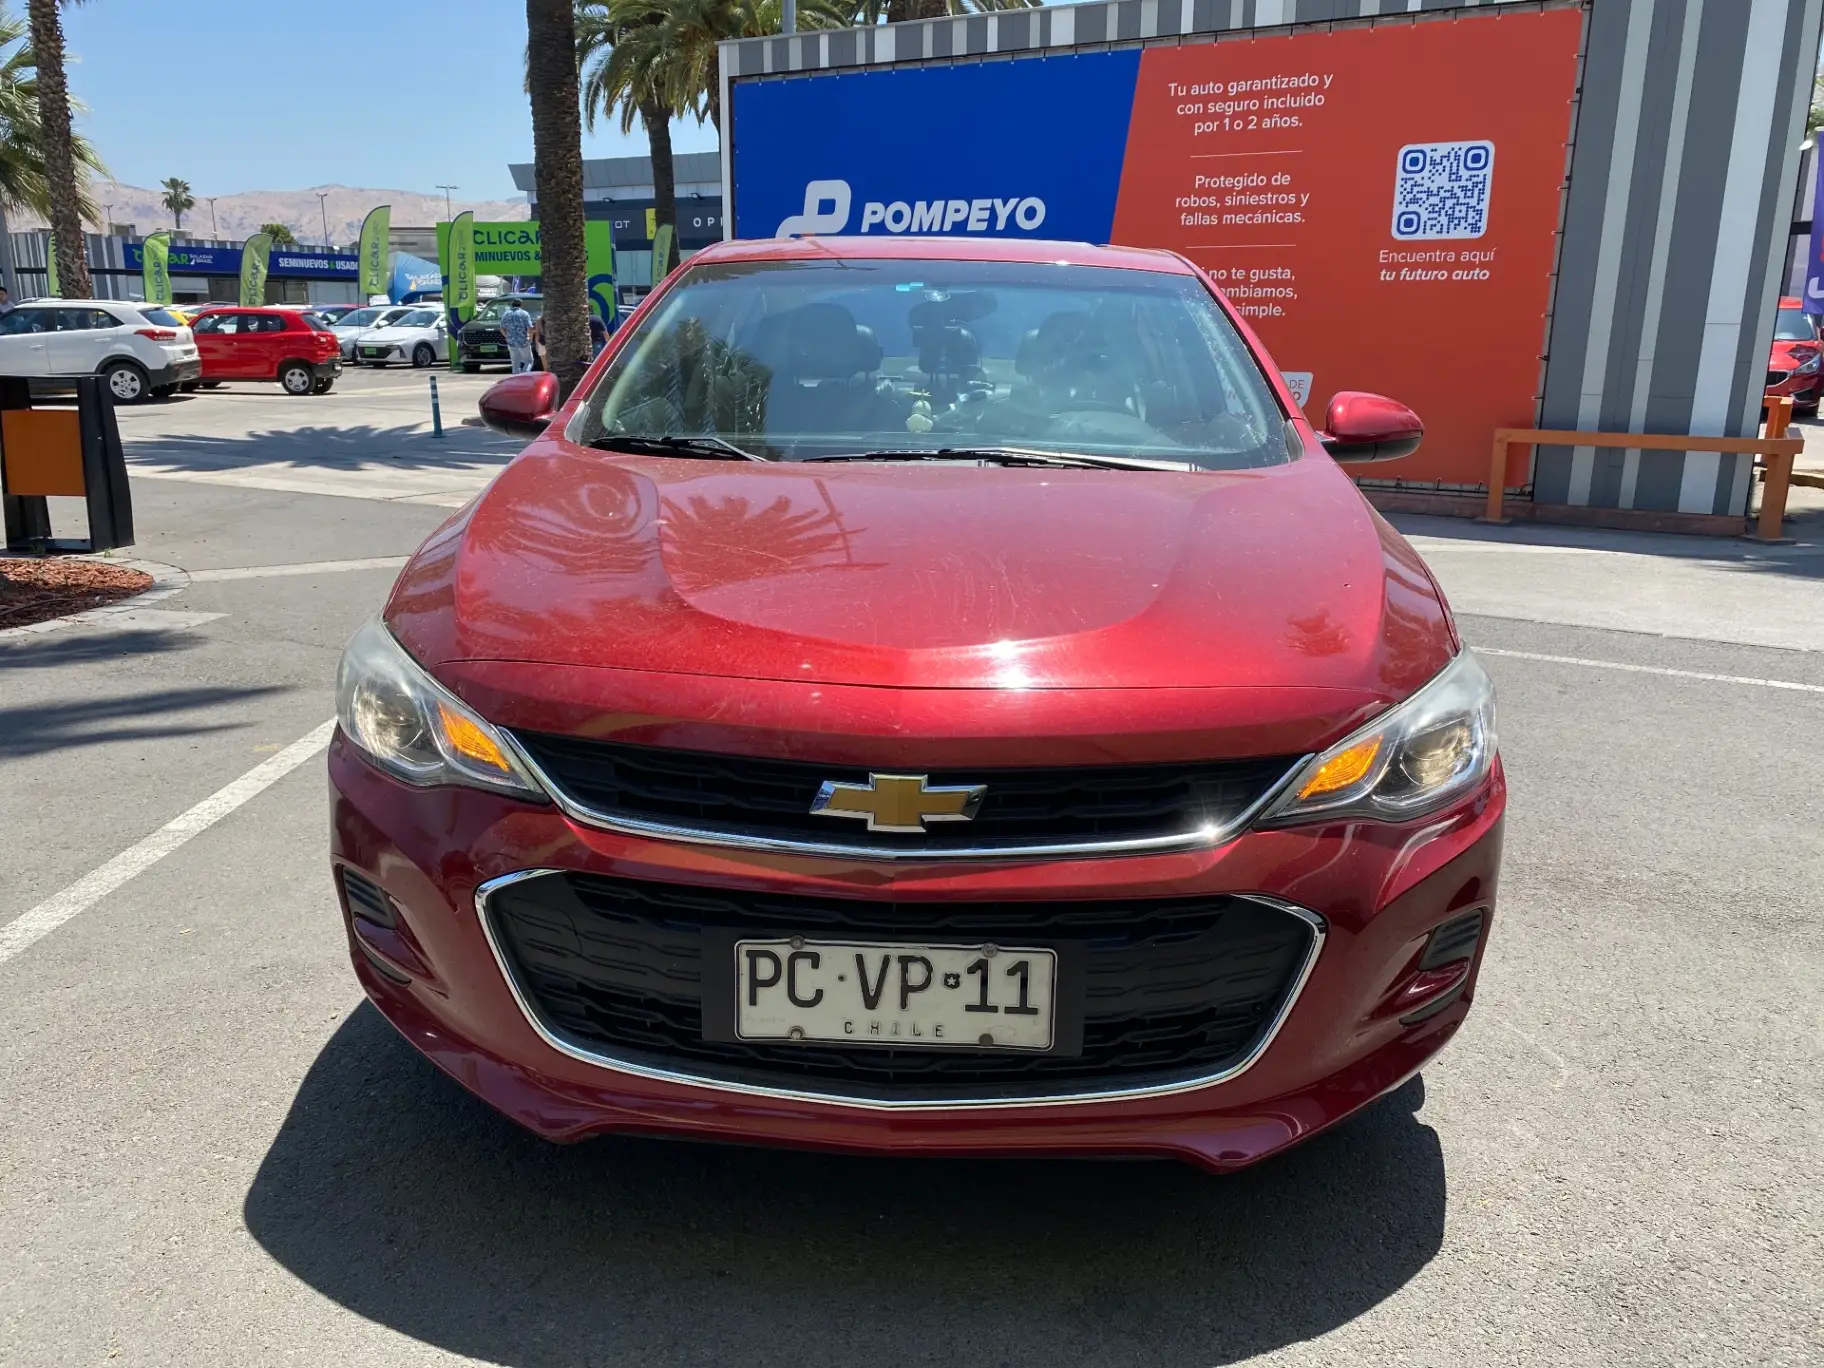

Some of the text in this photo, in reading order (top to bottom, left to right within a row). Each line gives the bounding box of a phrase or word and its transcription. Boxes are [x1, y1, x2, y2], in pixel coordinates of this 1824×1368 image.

[1168, 72, 1334, 97] Tu auto garantizado y
[1176, 92, 1325, 116] con seguro incluido
[1194, 113, 1303, 136] por 1 o 2 años.
[1195, 171, 1291, 190] Protegido de
[1175, 191, 1310, 209] robos, siniestros y
[861, 197, 1046, 233] POMPEYO
[1180, 209, 1306, 226] fallas mecánicas.
[279, 257, 329, 269] SEMINUEVOS
[474, 250, 531, 262] MINUEVOS
[1379, 247, 1497, 264] Encuentra aquí
[1208, 266, 1296, 283] no te gusta,
[1380, 267, 1490, 281] tu futuro auto
[1220, 284, 1298, 300] mbiamos,
[843, 1020, 945, 1038] CHILE
